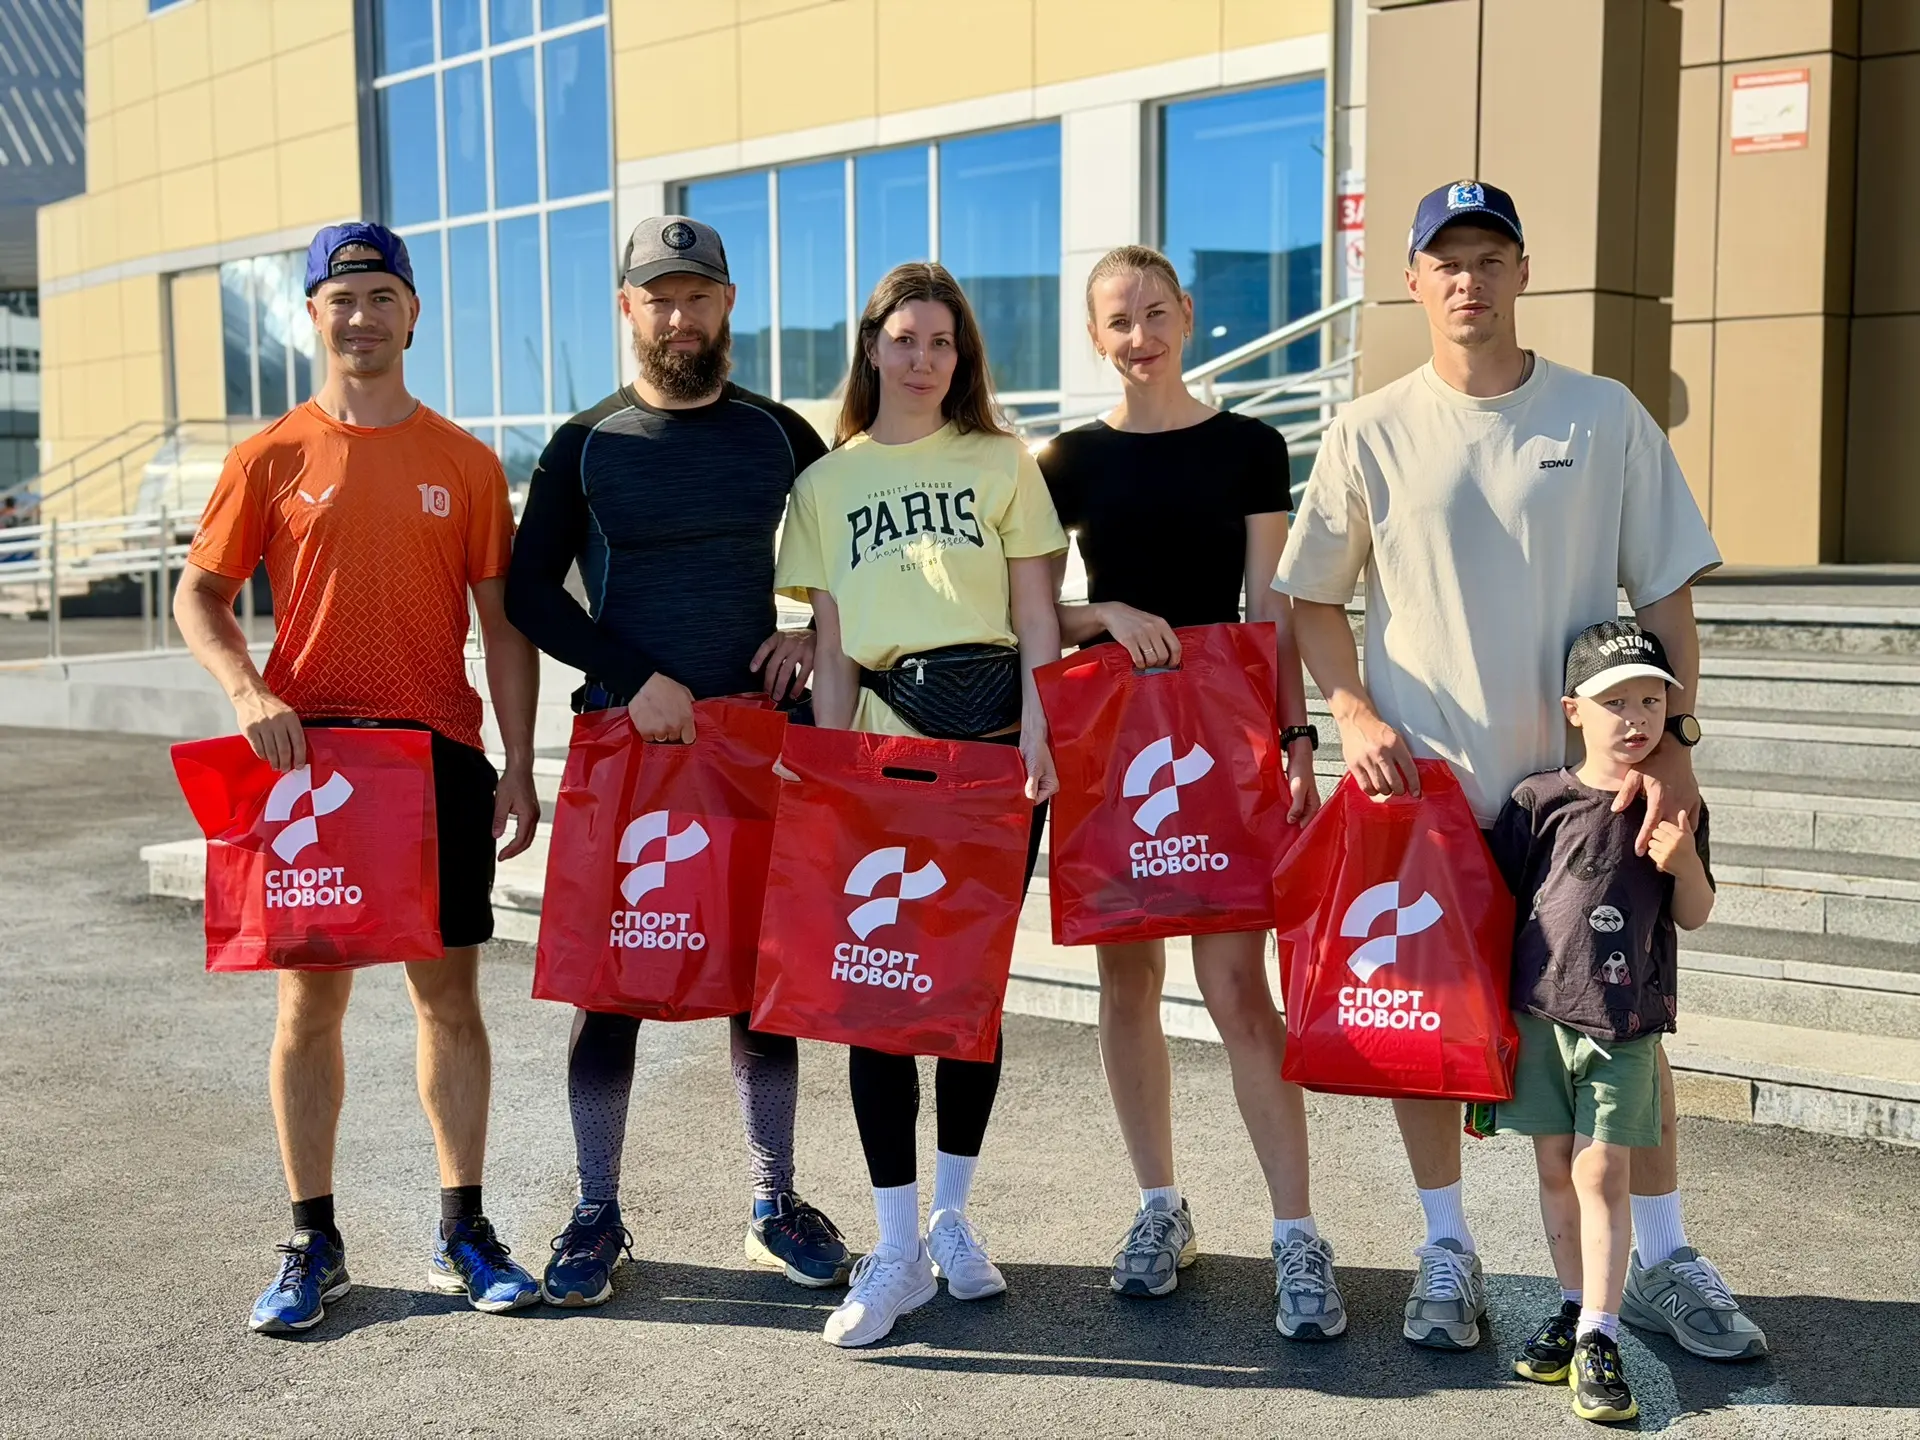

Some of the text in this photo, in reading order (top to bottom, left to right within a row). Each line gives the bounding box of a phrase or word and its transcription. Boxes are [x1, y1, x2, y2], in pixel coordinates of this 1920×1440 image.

[416, 483, 451, 518] 10
[867, 481, 953, 500] VARSITY LEAGUE
[846, 487, 985, 571] PARIS
[1129, 835, 1209, 860] СПОРТ
[265, 866, 345, 888] СПОРТ
[1131, 853, 1229, 879] НОВОГО
[266, 886, 362, 908] НОВОГО
[611, 910, 691, 931] СПОРТ
[609, 929, 705, 951] НОВОГО
[834, 942, 919, 972] СПОРТ
[831, 961, 933, 993] НОВОГО
[1338, 987, 1424, 1010] СПОРТ
[1337, 1006, 1441, 1032] НОВОГО
